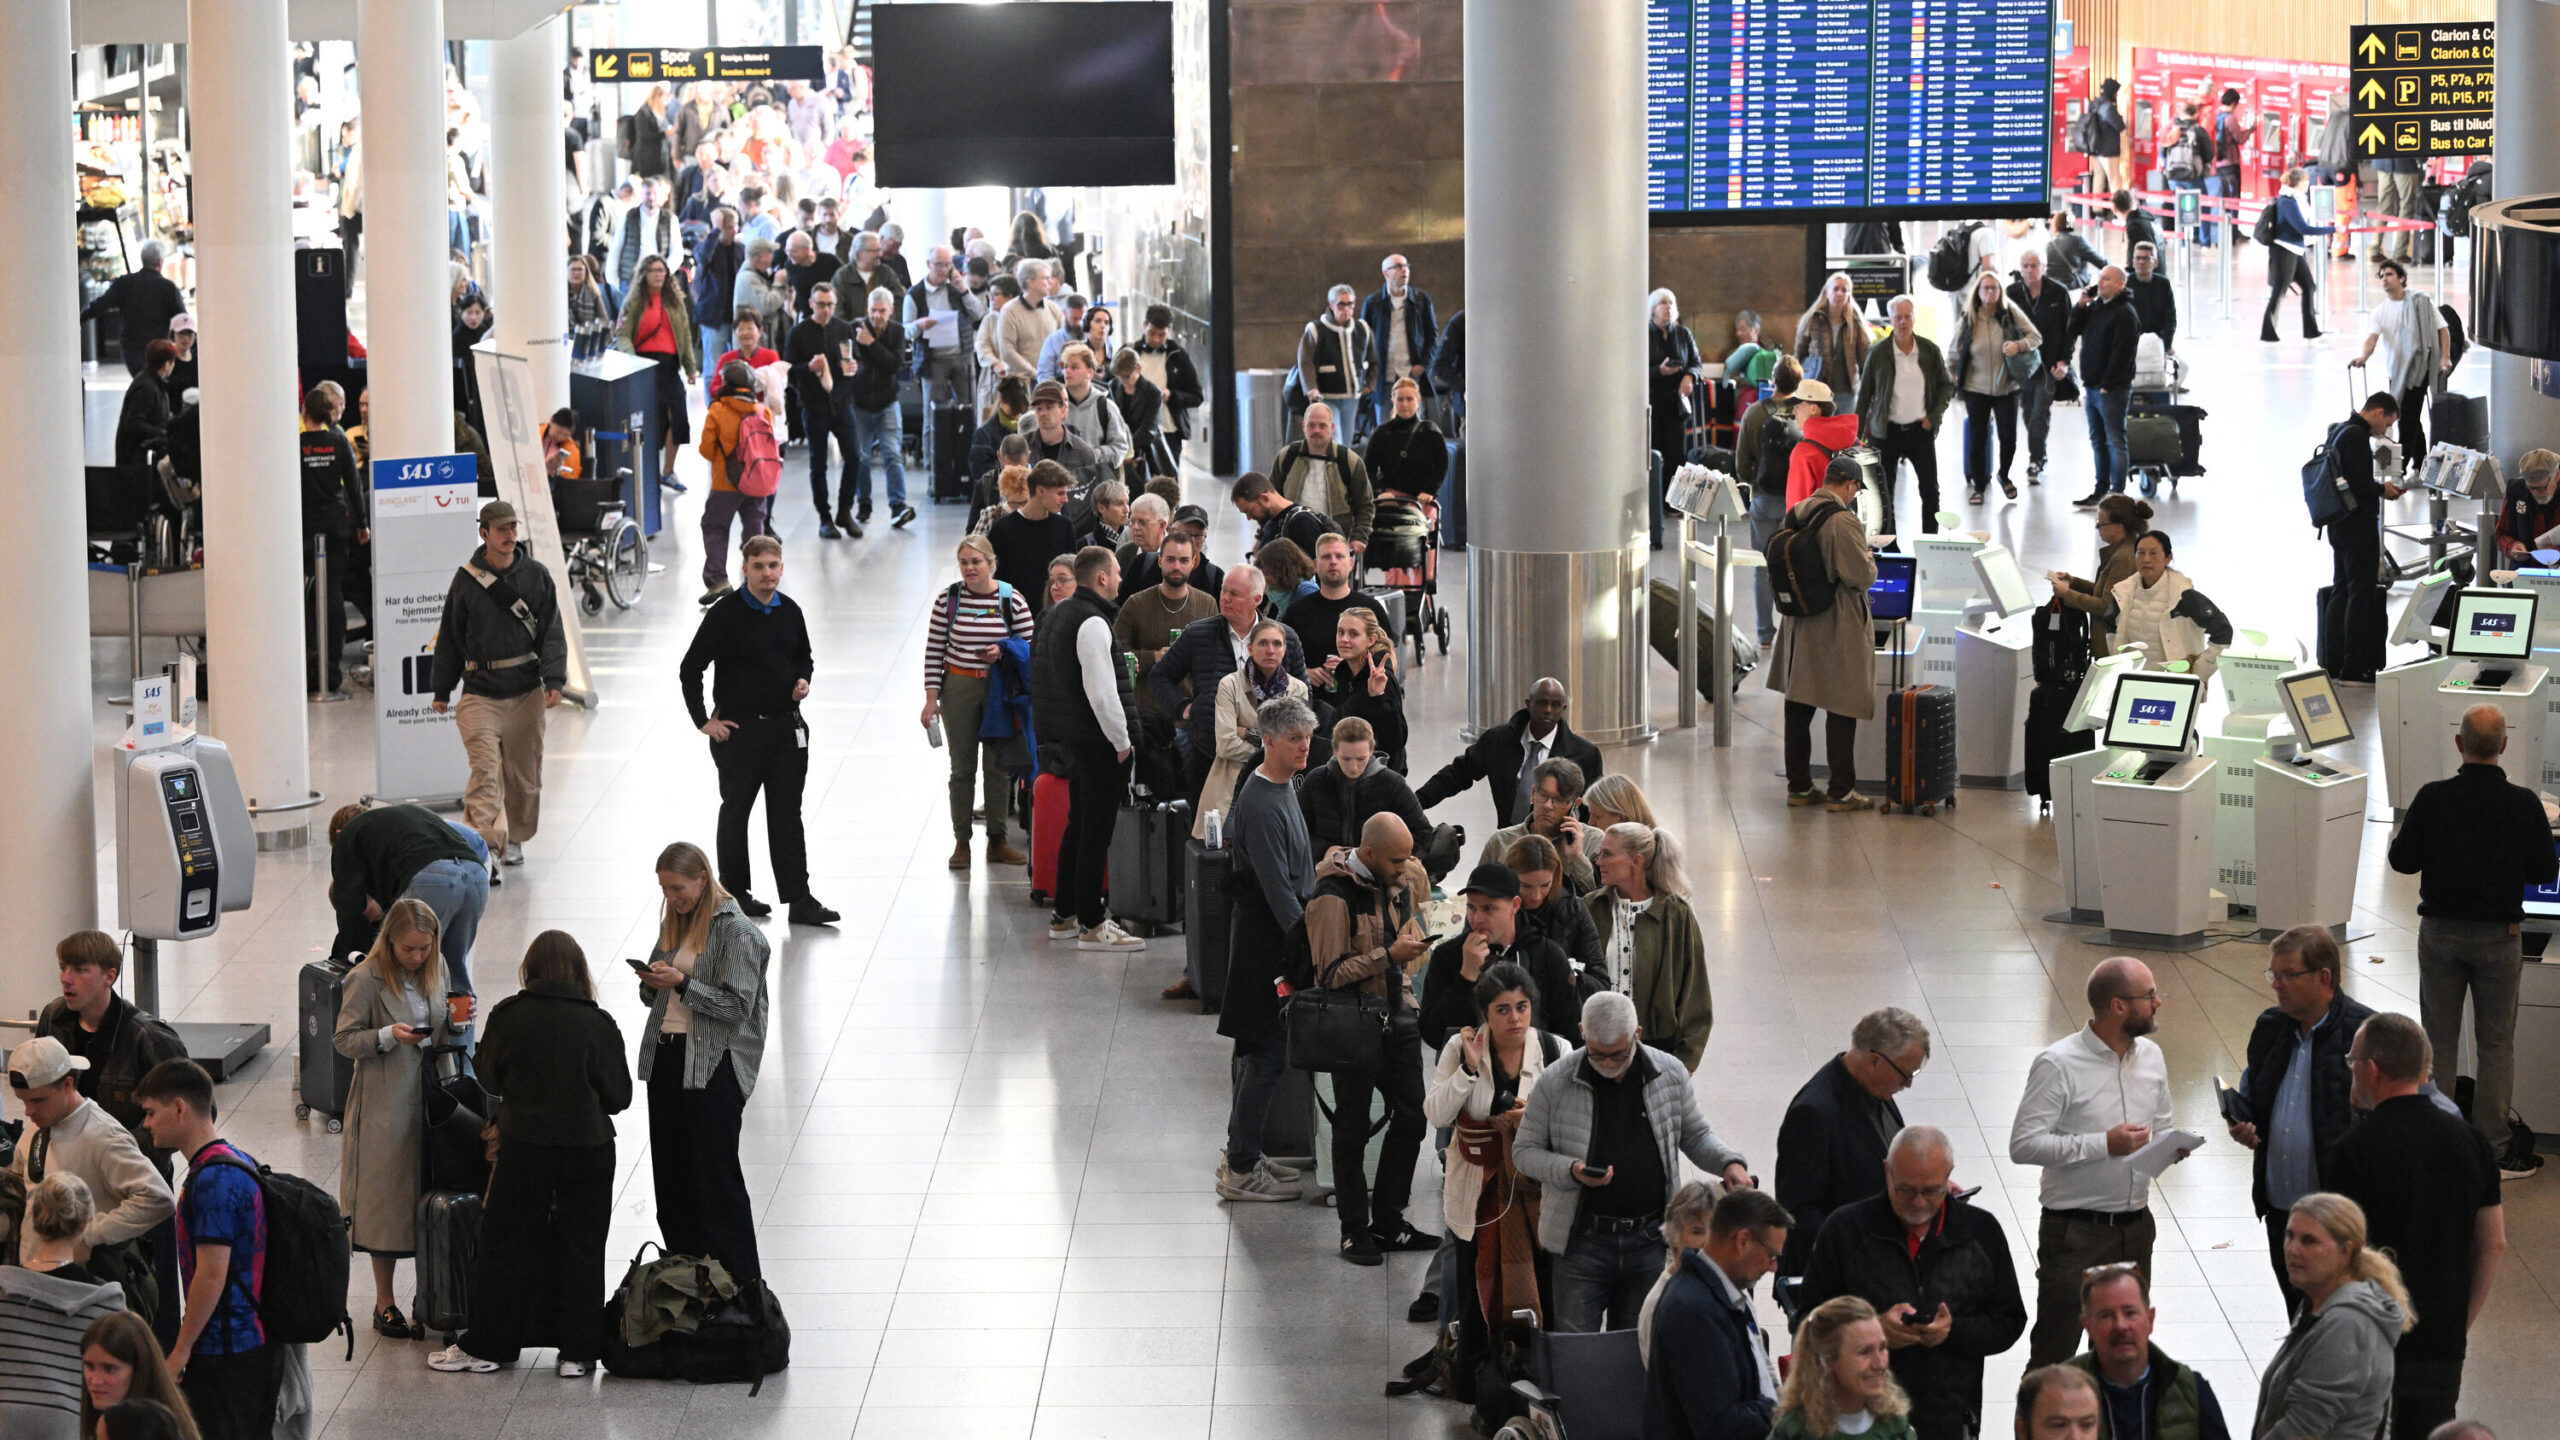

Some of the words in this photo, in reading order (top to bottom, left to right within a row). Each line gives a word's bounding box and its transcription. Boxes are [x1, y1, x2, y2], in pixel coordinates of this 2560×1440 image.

[2431, 29, 2470, 42] Clarion
[2472, 28, 2480, 40] &
[2431, 47, 2470, 60] Clarion
[2472, 46, 2480, 58] &
[660, 50, 690, 64] Spor
[704, 52, 714, 76] 1
[660, 64, 696, 76] Track
[2431, 74, 2448, 87] P5,
[2450, 74, 2474, 86] P7a,
[2431, 92, 2450, 106] P11,
[2452, 92, 2474, 105] P15,
[2431, 120, 2450, 131] Bus
[2453, 119, 2464, 131] til
[2431, 138, 2450, 150] Bus
[2454, 138, 2465, 149] to
[2467, 136, 2486, 148] Car
[398, 462, 434, 480] SAS
[385, 597, 400, 606] Har
[403, 596, 414, 604] du
[2480, 618, 2498, 626] SAS
[143, 686, 162, 699] SAS
[386, 708, 419, 718] Already
[2139, 705, 2158, 713] SAS
